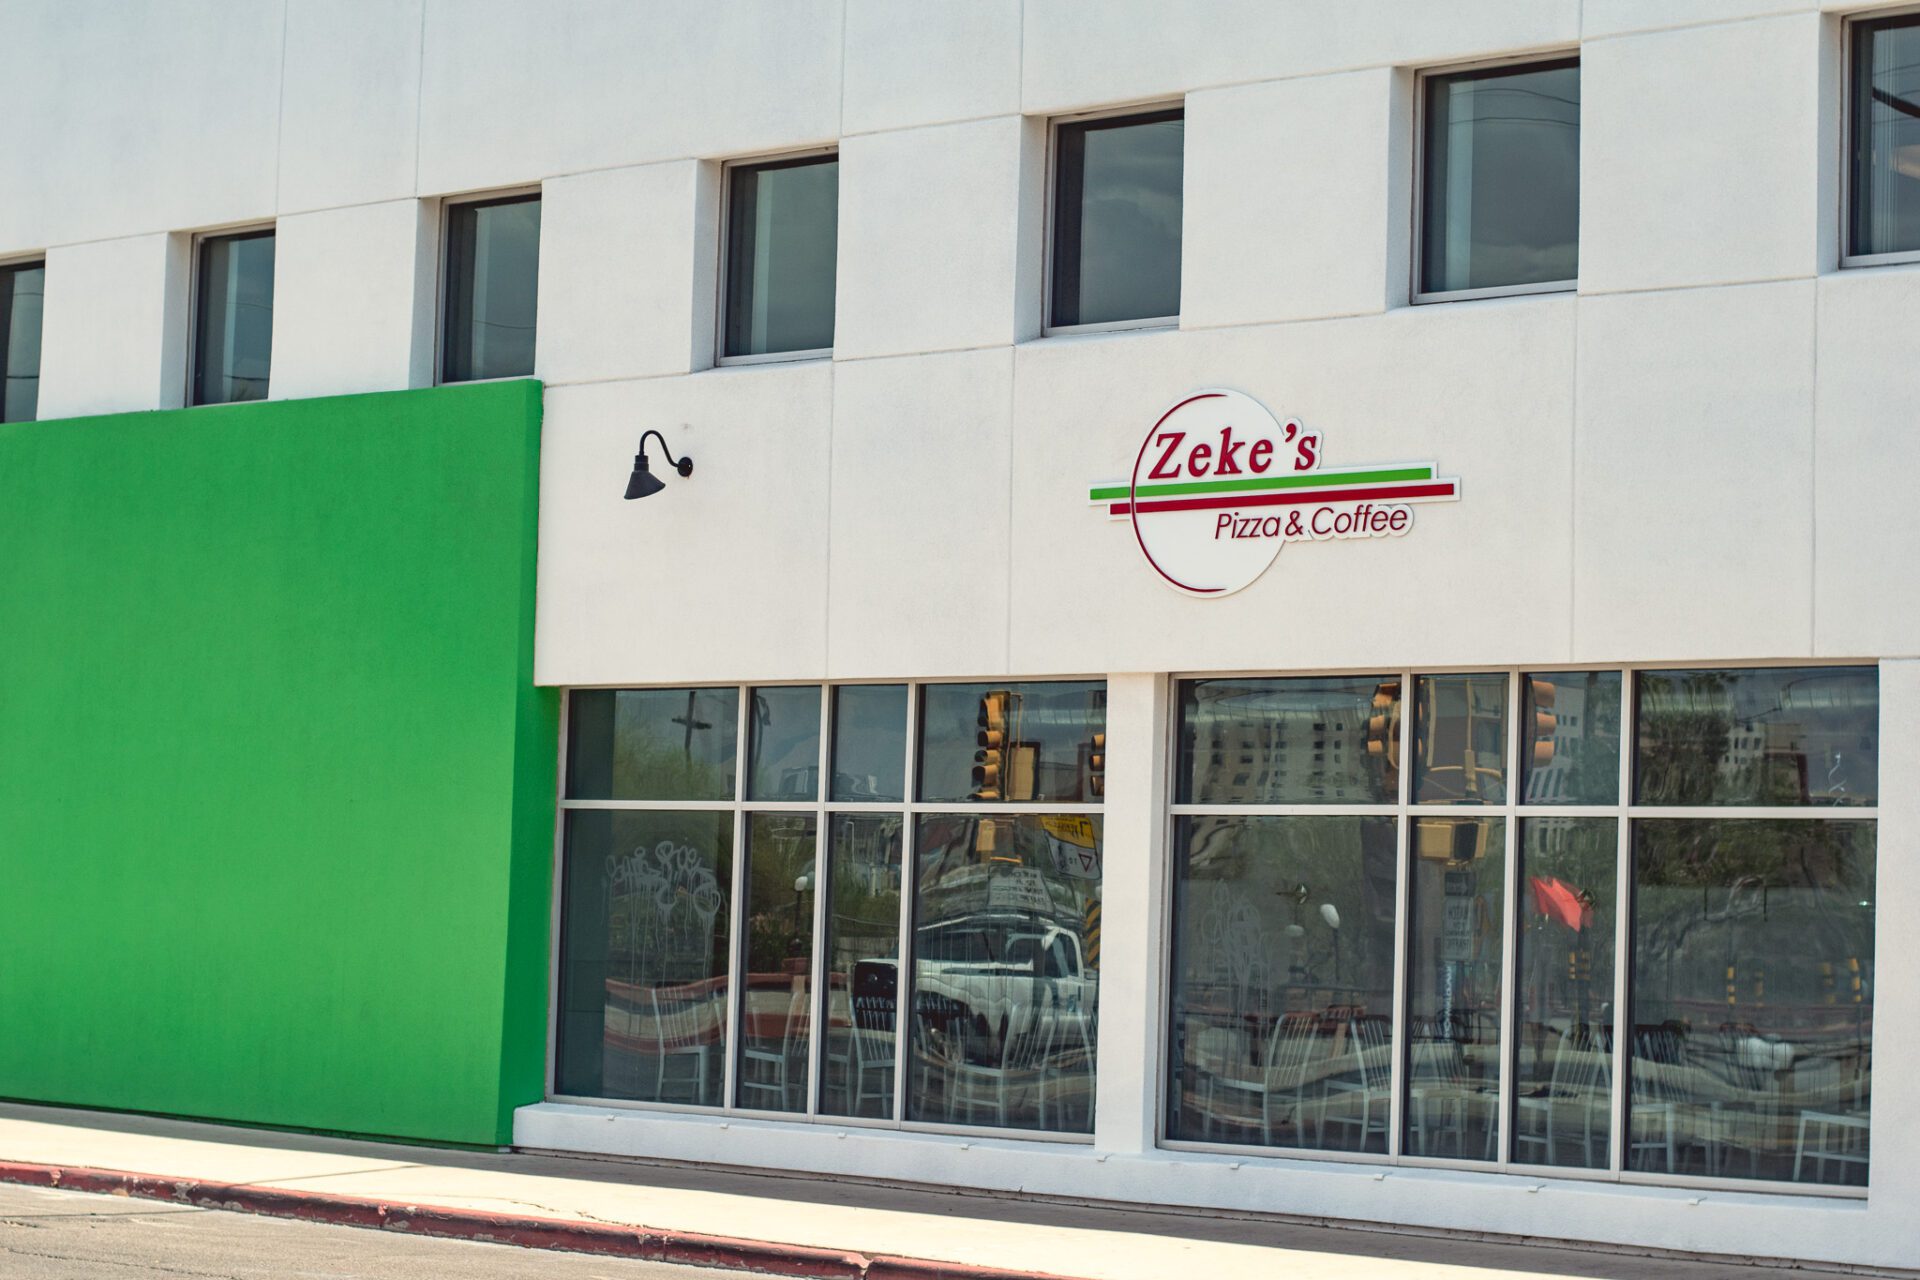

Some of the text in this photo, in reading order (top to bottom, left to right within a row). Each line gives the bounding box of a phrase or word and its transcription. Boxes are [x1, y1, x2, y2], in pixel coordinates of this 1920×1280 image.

[1147, 423, 1317, 480] Zeke's
[1215, 503, 1408, 540] Pizza & Coffee
